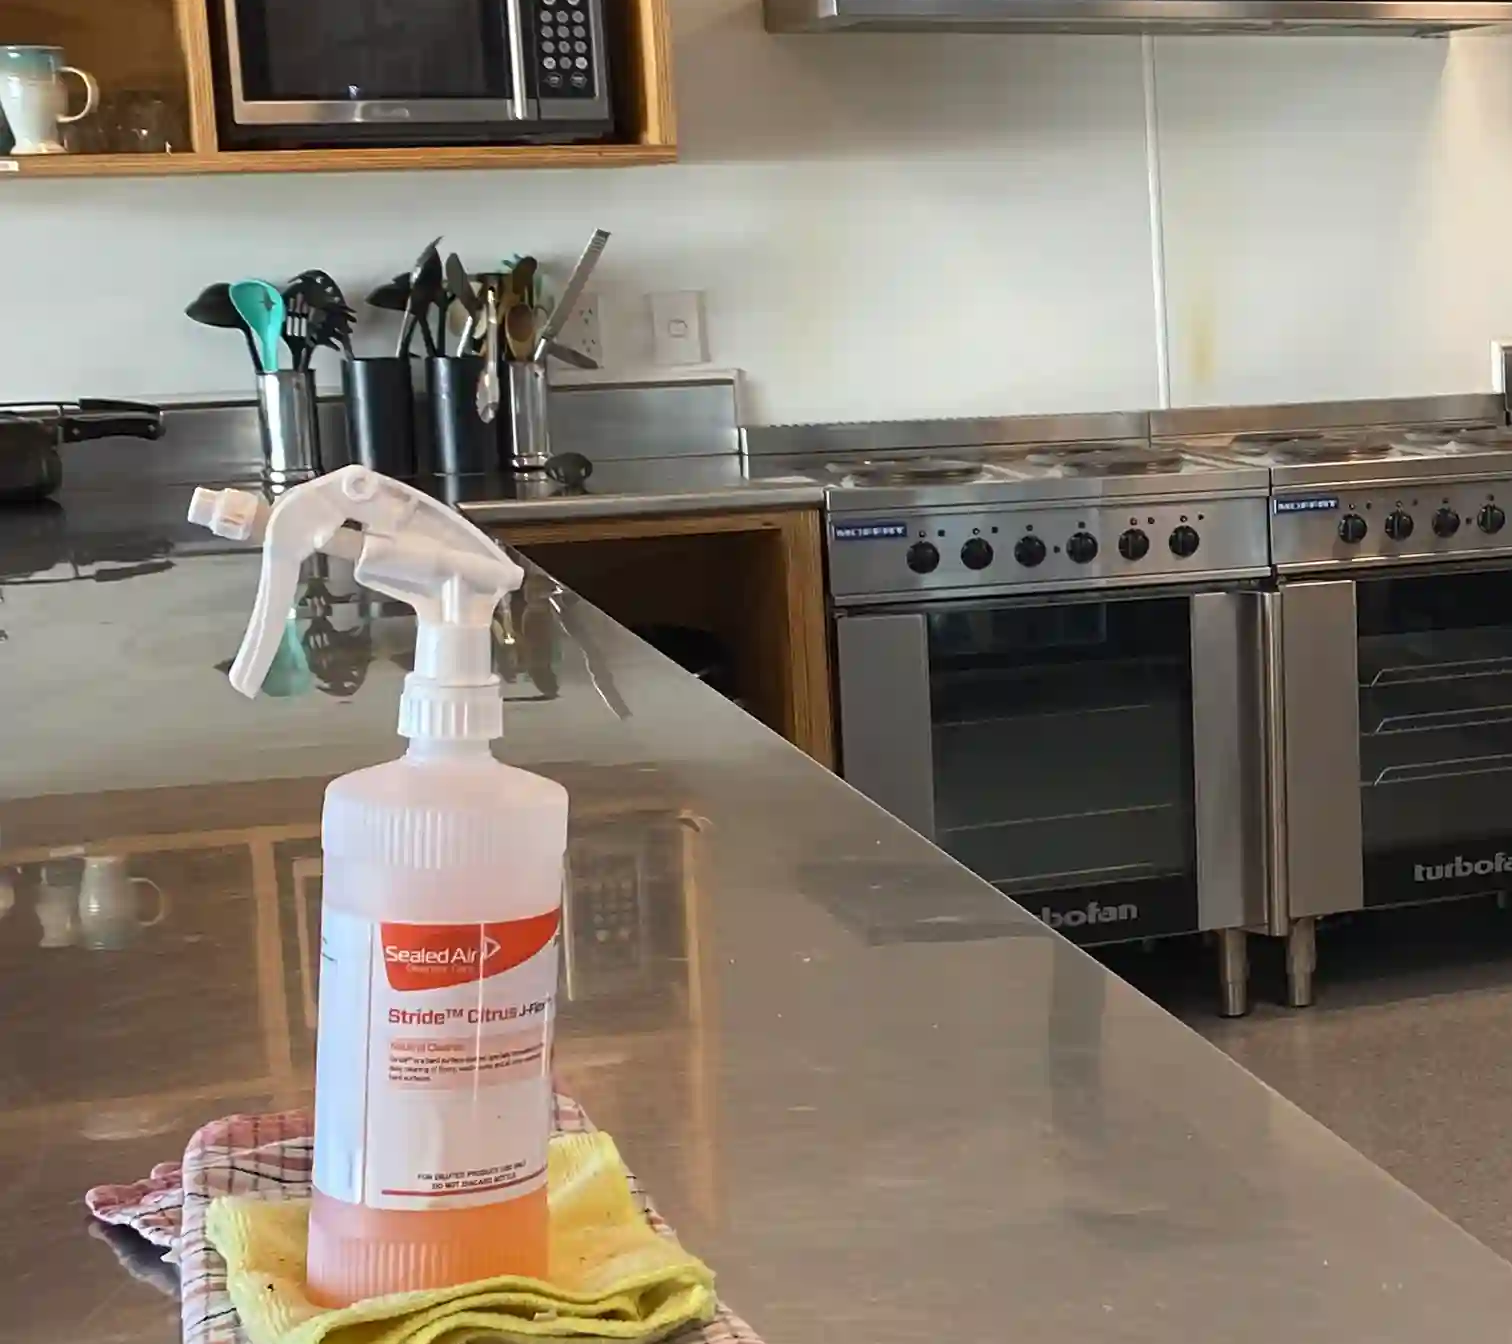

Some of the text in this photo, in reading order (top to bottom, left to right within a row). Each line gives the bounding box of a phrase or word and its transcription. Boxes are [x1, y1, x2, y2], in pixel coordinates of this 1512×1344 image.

[385, 944, 477, 964] Sealed Air
[467, 1007, 517, 1024] Citrus
